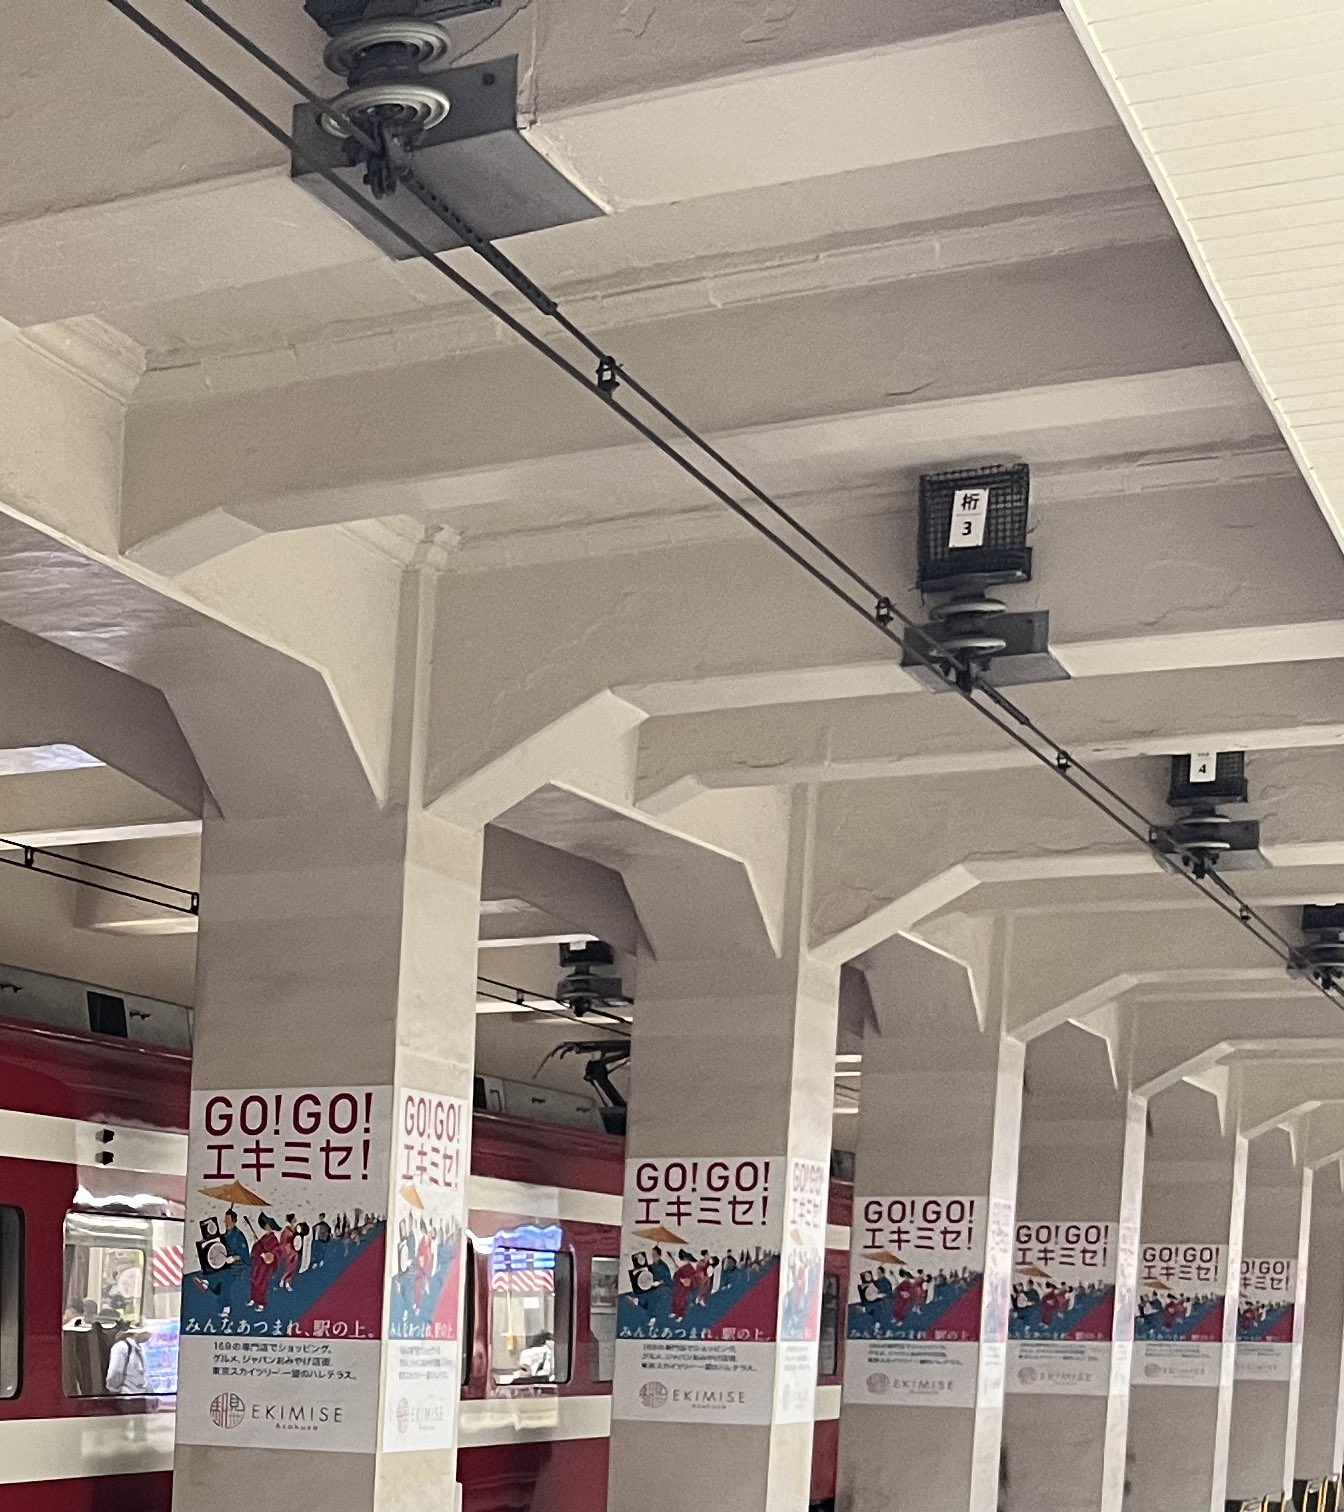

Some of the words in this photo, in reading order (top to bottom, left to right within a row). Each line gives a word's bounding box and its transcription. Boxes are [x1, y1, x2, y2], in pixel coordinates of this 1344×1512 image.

[961, 521, 972, 536] 3
[203, 1139, 370, 1182] エキミセ!
[672, 1389, 746, 1404] EKIMISE
[252, 1403, 344, 1424] EKIMISE
